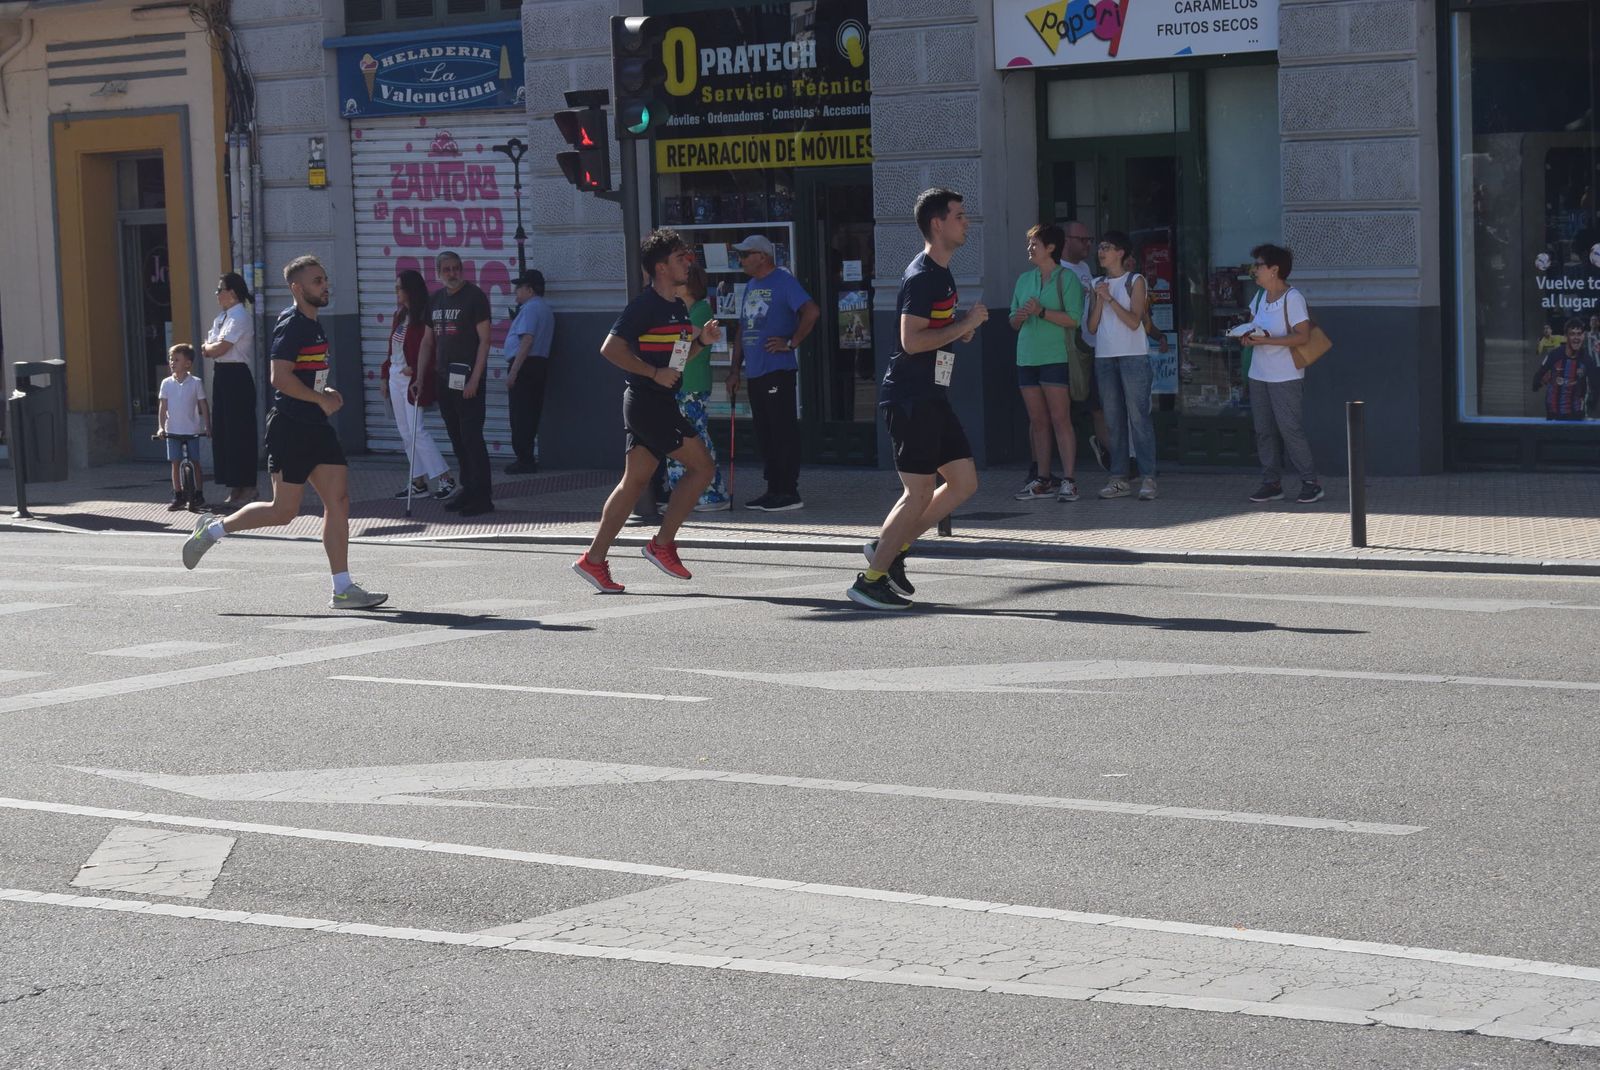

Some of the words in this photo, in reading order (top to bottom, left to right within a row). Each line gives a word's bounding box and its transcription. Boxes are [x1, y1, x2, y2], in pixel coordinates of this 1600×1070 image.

[1174, 0, 1258, 14] CARAMELOS
[1157, 21, 1209, 37] FRUTOS
[1213, 17, 1258, 33] SECOS
[381, 46, 492, 67] HELADERIA
[419, 62, 457, 83] La
[381, 80, 497, 104] Valenciana
[702, 82, 784, 103] Servicio
[707, 111, 765, 124] Ordenadores
[772, 106, 815, 120] Consolas
[667, 136, 771, 168] REPARACIÓN
[776, 139, 796, 162] DE
[390, 160, 500, 202] ZAMORA
[392, 206, 504, 250] CIUDAD
[1535, 275, 1585, 290] Vuelve
[1541, 293, 1556, 308] al
[1558, 293, 1598, 312] lugar
